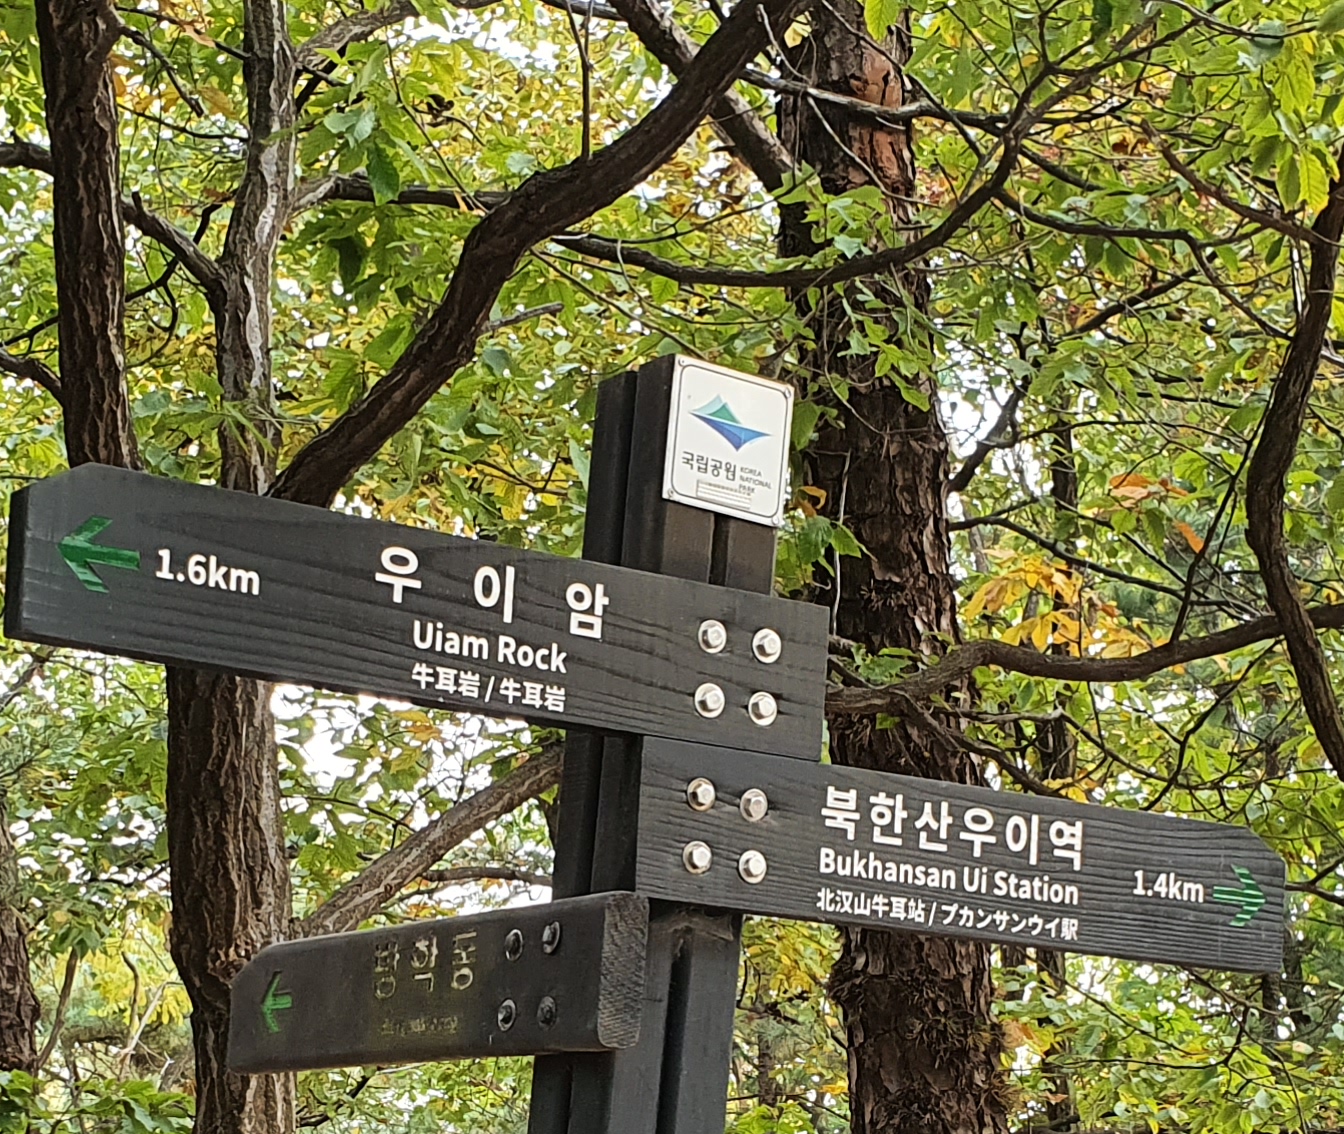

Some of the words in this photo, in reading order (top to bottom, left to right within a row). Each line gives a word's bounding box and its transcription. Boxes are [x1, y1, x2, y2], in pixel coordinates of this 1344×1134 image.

[681, 451, 737, 482] 국립공원
[739, 466, 763, 477] KOREA
[739, 475, 771, 490] NATIONAL
[155, 547, 260, 597] 1.6km
[412, 619, 490, 661] Uiam
[497, 634, 568, 674] Rock
[820, 785, 1084, 872] 북한산우이역
[819, 847, 956, 890] Bukhansan
[962, 866, 988, 894] Ui
[993, 870, 1079, 906] Station
[1132, 869, 1205, 904] 1.4km
